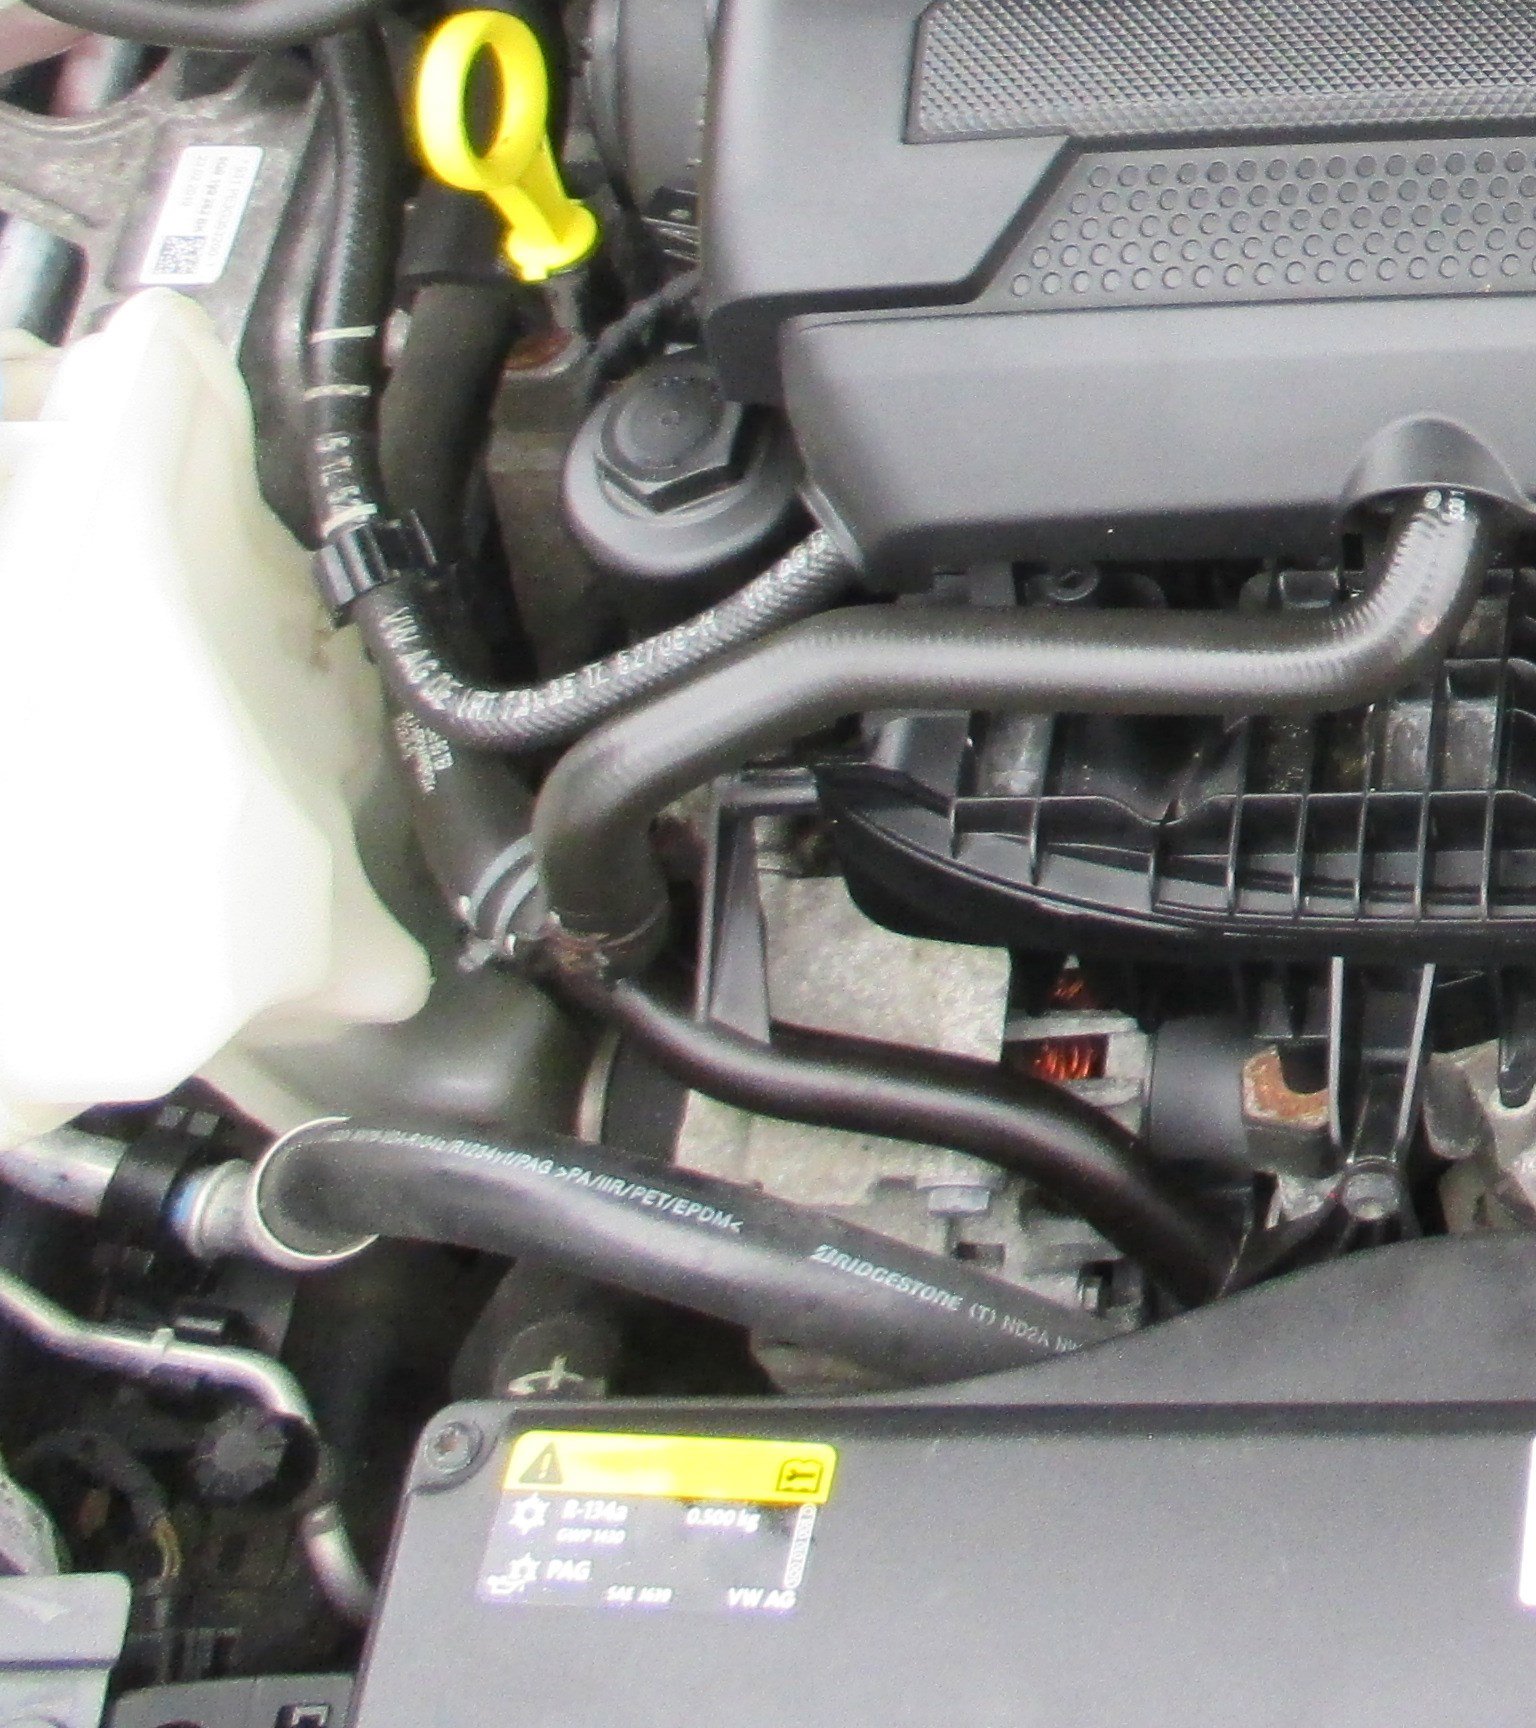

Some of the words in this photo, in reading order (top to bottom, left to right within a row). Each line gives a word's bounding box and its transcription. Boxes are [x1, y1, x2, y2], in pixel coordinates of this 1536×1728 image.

[384, 606, 421, 649] VW
[806, 1242, 966, 1312] BRIDGESTONE
[562, 1498, 628, 1521] R-134a
[736, 1508, 759, 1532] kg
[546, 1558, 591, 1581] PAG
[726, 1587, 764, 1609] VW
[764, 1588, 797, 1610] AG
